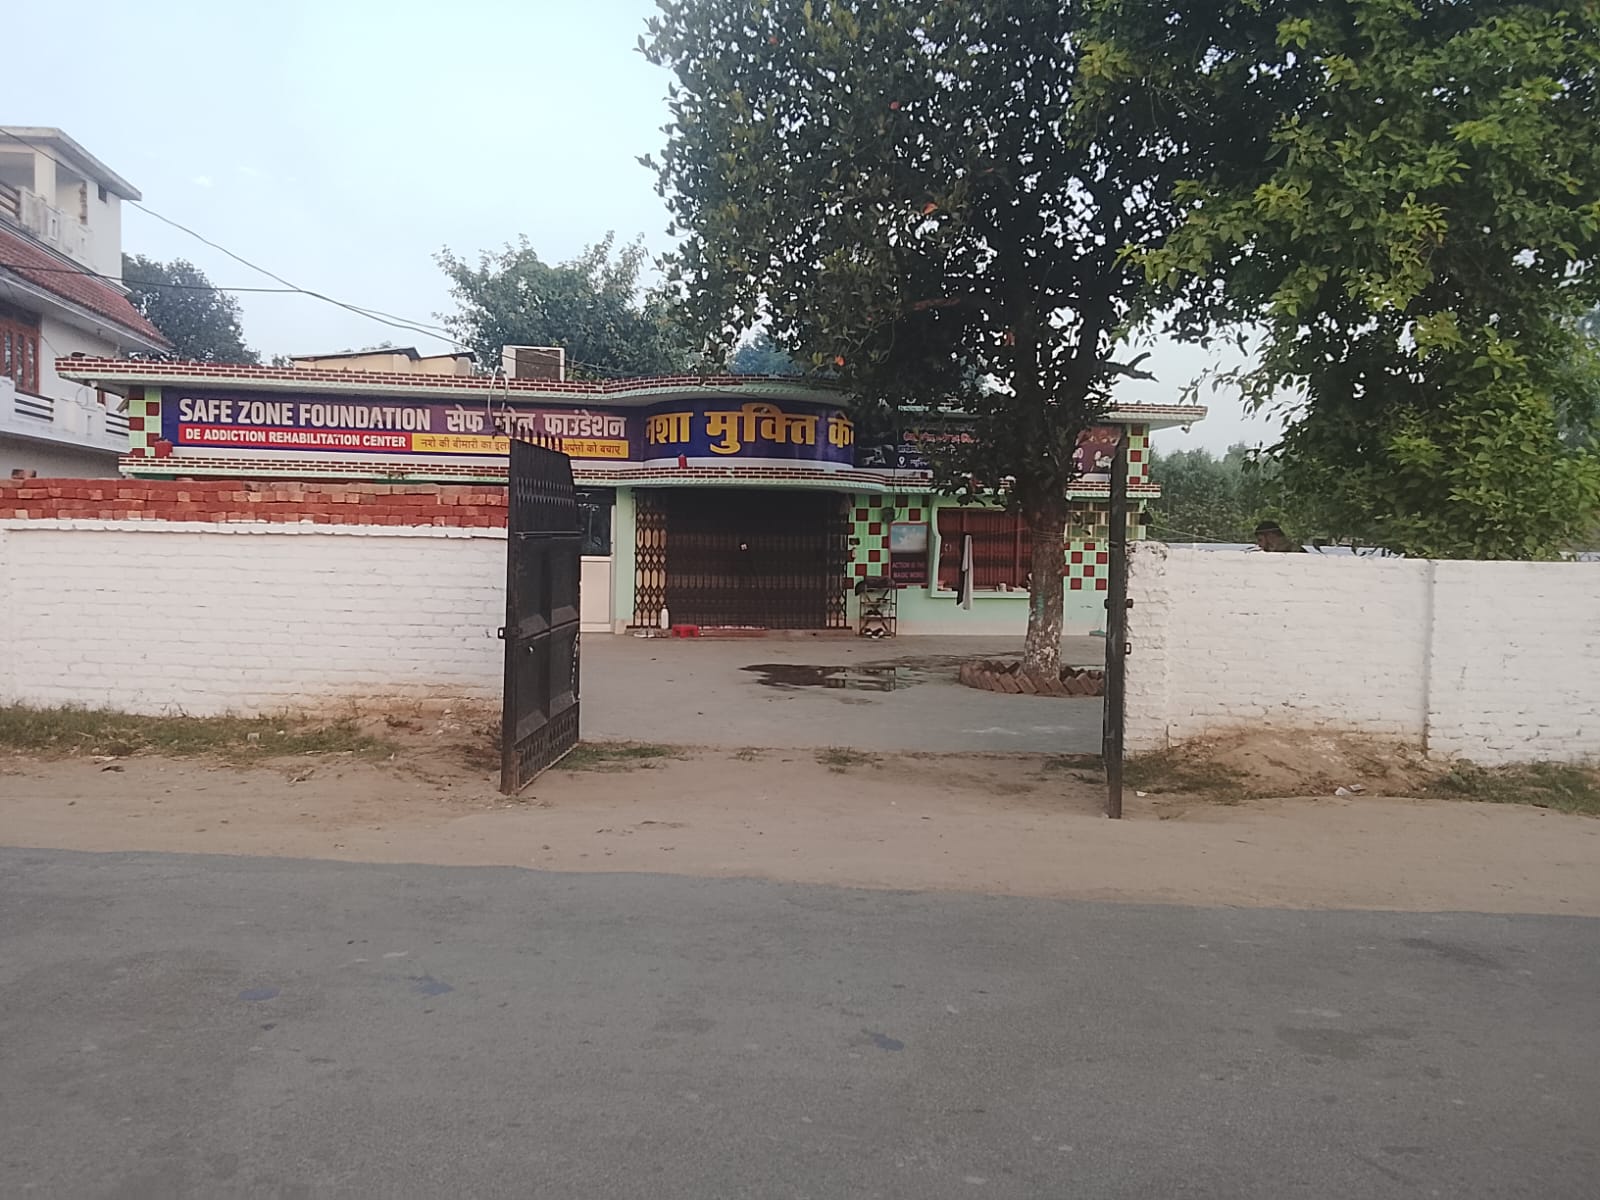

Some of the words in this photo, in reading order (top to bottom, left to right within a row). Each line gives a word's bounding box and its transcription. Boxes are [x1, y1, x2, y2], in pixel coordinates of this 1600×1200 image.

[179, 398, 233, 423] SAFE
[238, 401, 294, 425] ZONE
[299, 403, 432, 431] FOUNDATION
[445, 404, 485, 432] सेफ
[543, 409, 627, 437] फाउंडेशन
[645, 411, 694, 445] नशा
[703, 402, 819, 455] मुक्ति
[185, 427, 201, 440] DE
[204, 429, 266, 443] ADDICTION
[268, 432, 360, 447] REHABILITATION
[363, 435, 406, 448] CENTER
